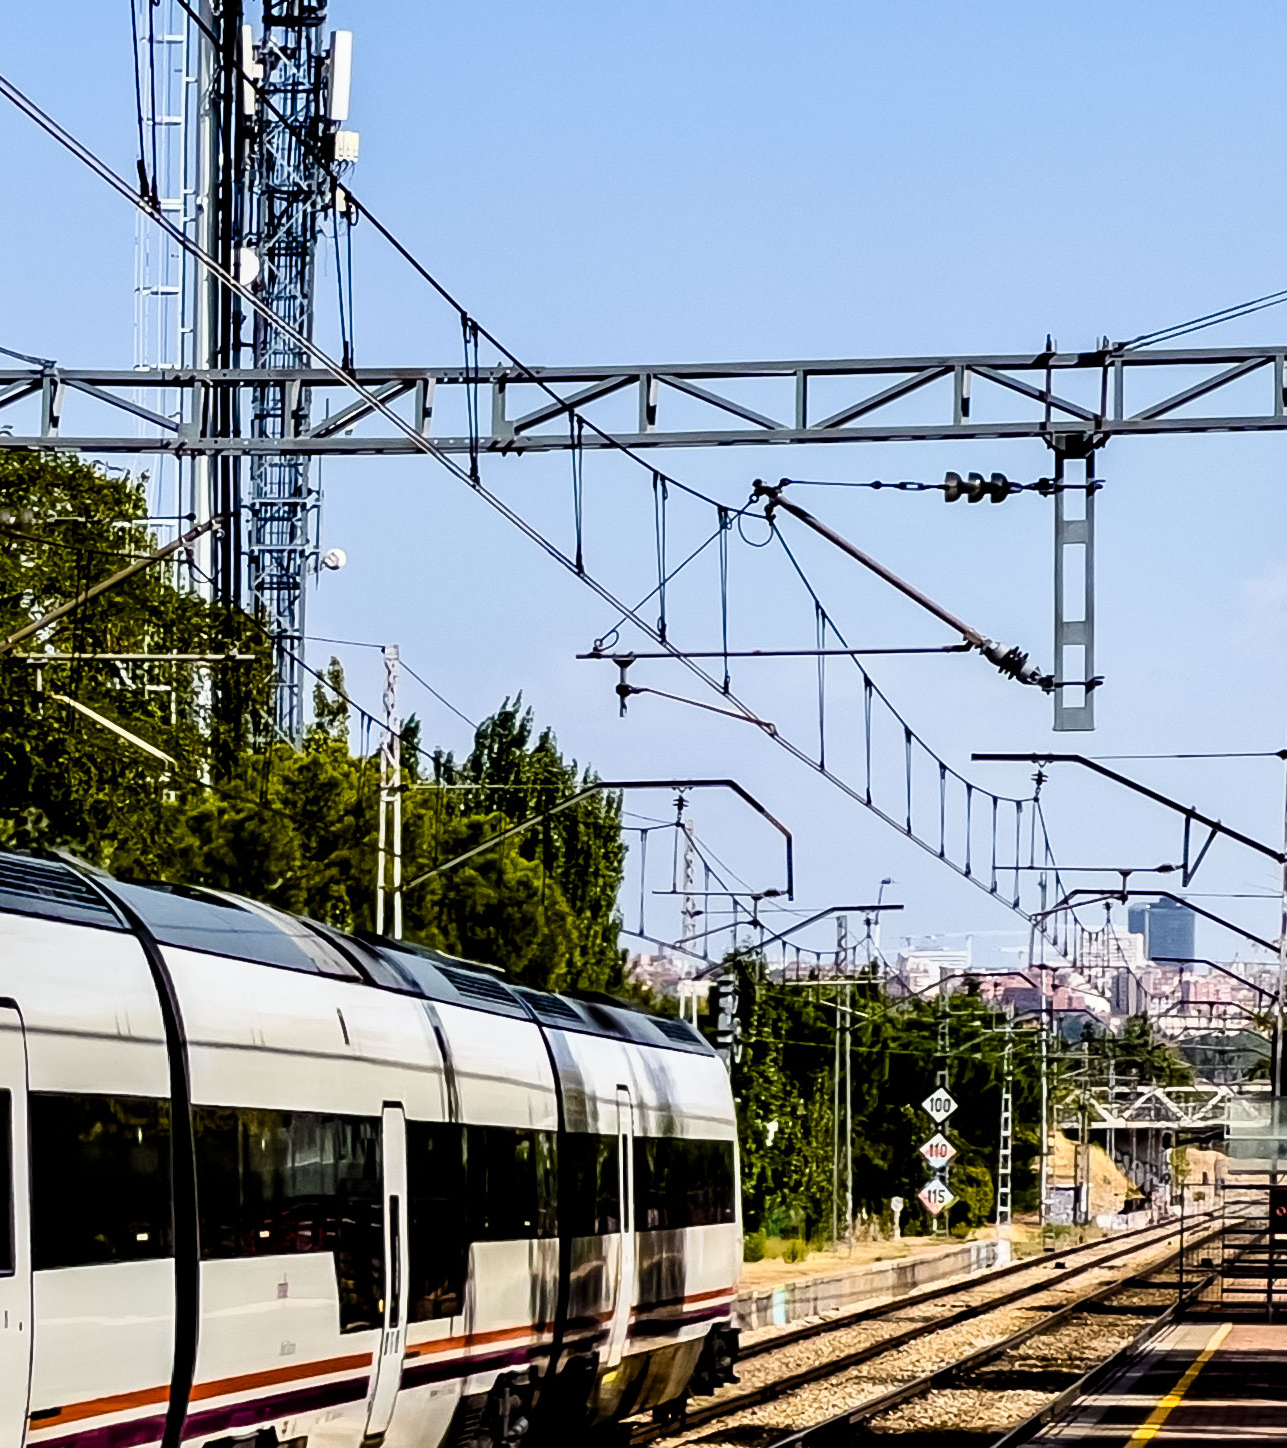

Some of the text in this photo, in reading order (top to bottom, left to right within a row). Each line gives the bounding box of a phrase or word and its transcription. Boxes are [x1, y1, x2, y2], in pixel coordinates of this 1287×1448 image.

[929, 1097, 952, 1113] 100
[928, 1143, 948, 1158] 110
[927, 1189, 946, 1204] 115
